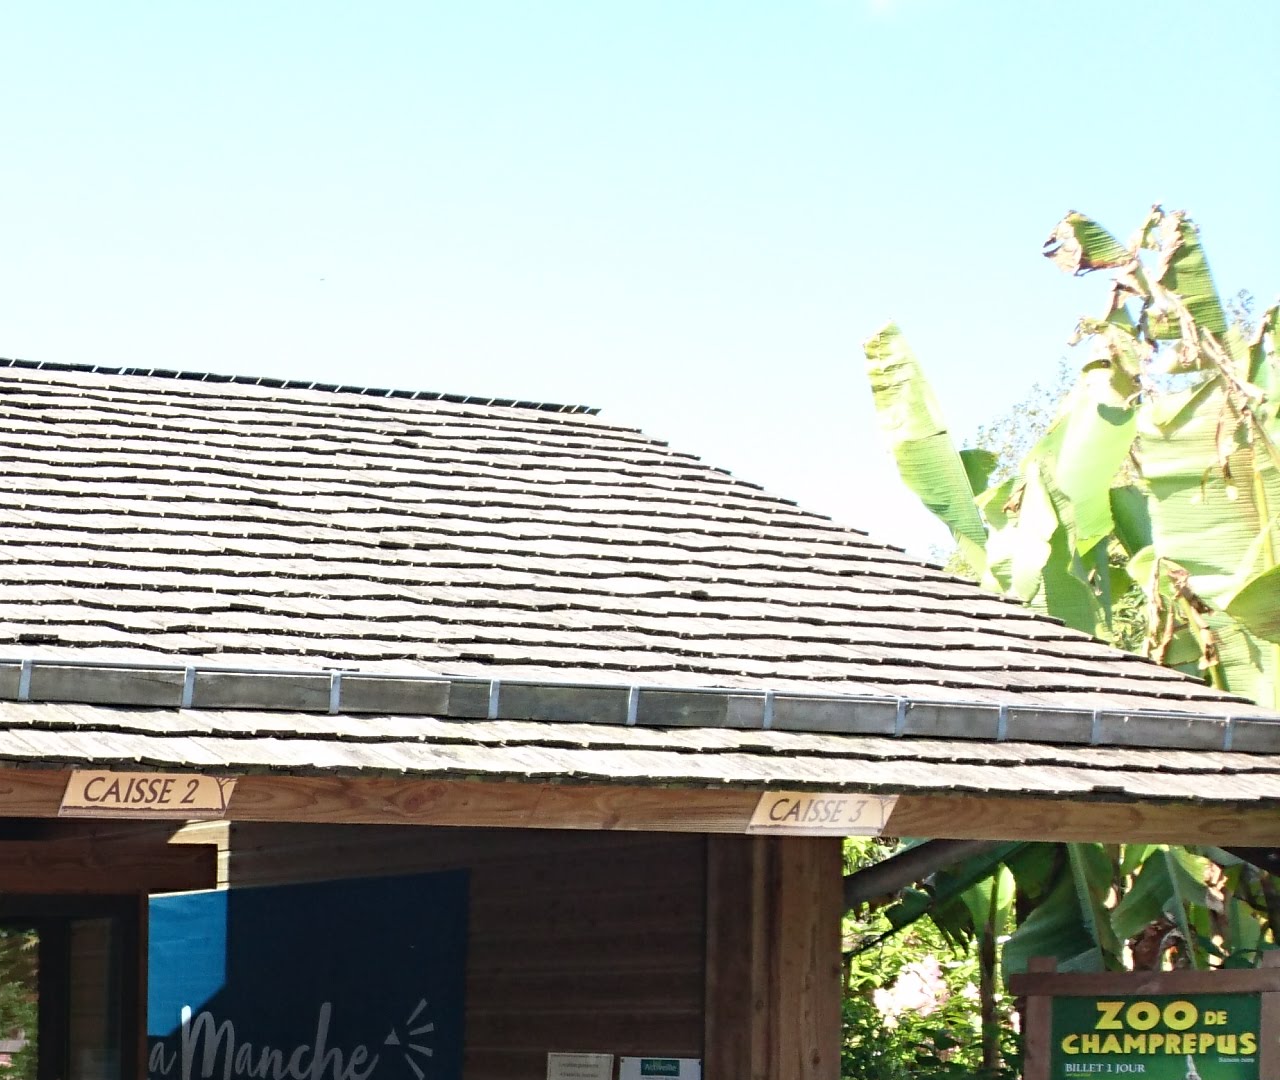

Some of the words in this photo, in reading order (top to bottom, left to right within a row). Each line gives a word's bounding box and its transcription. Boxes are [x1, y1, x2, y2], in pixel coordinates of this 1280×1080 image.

[83, 776, 176, 804] CAISSE
[180, 779, 200, 804] 2
[769, 798, 843, 823] CAISSE
[849, 800, 866, 823] 3
[1095, 1000, 1198, 1031] ZOO
[1204, 1011, 1228, 1025] DE
[1062, 1032, 1257, 1055] CHAMPREPUS
[148, 1041, 177, 1075] a
[1065, 1063, 1104, 1073] BILLET
[1107, 1064, 1113, 1073] 1
[1115, 1064, 1145, 1074] JOUR
